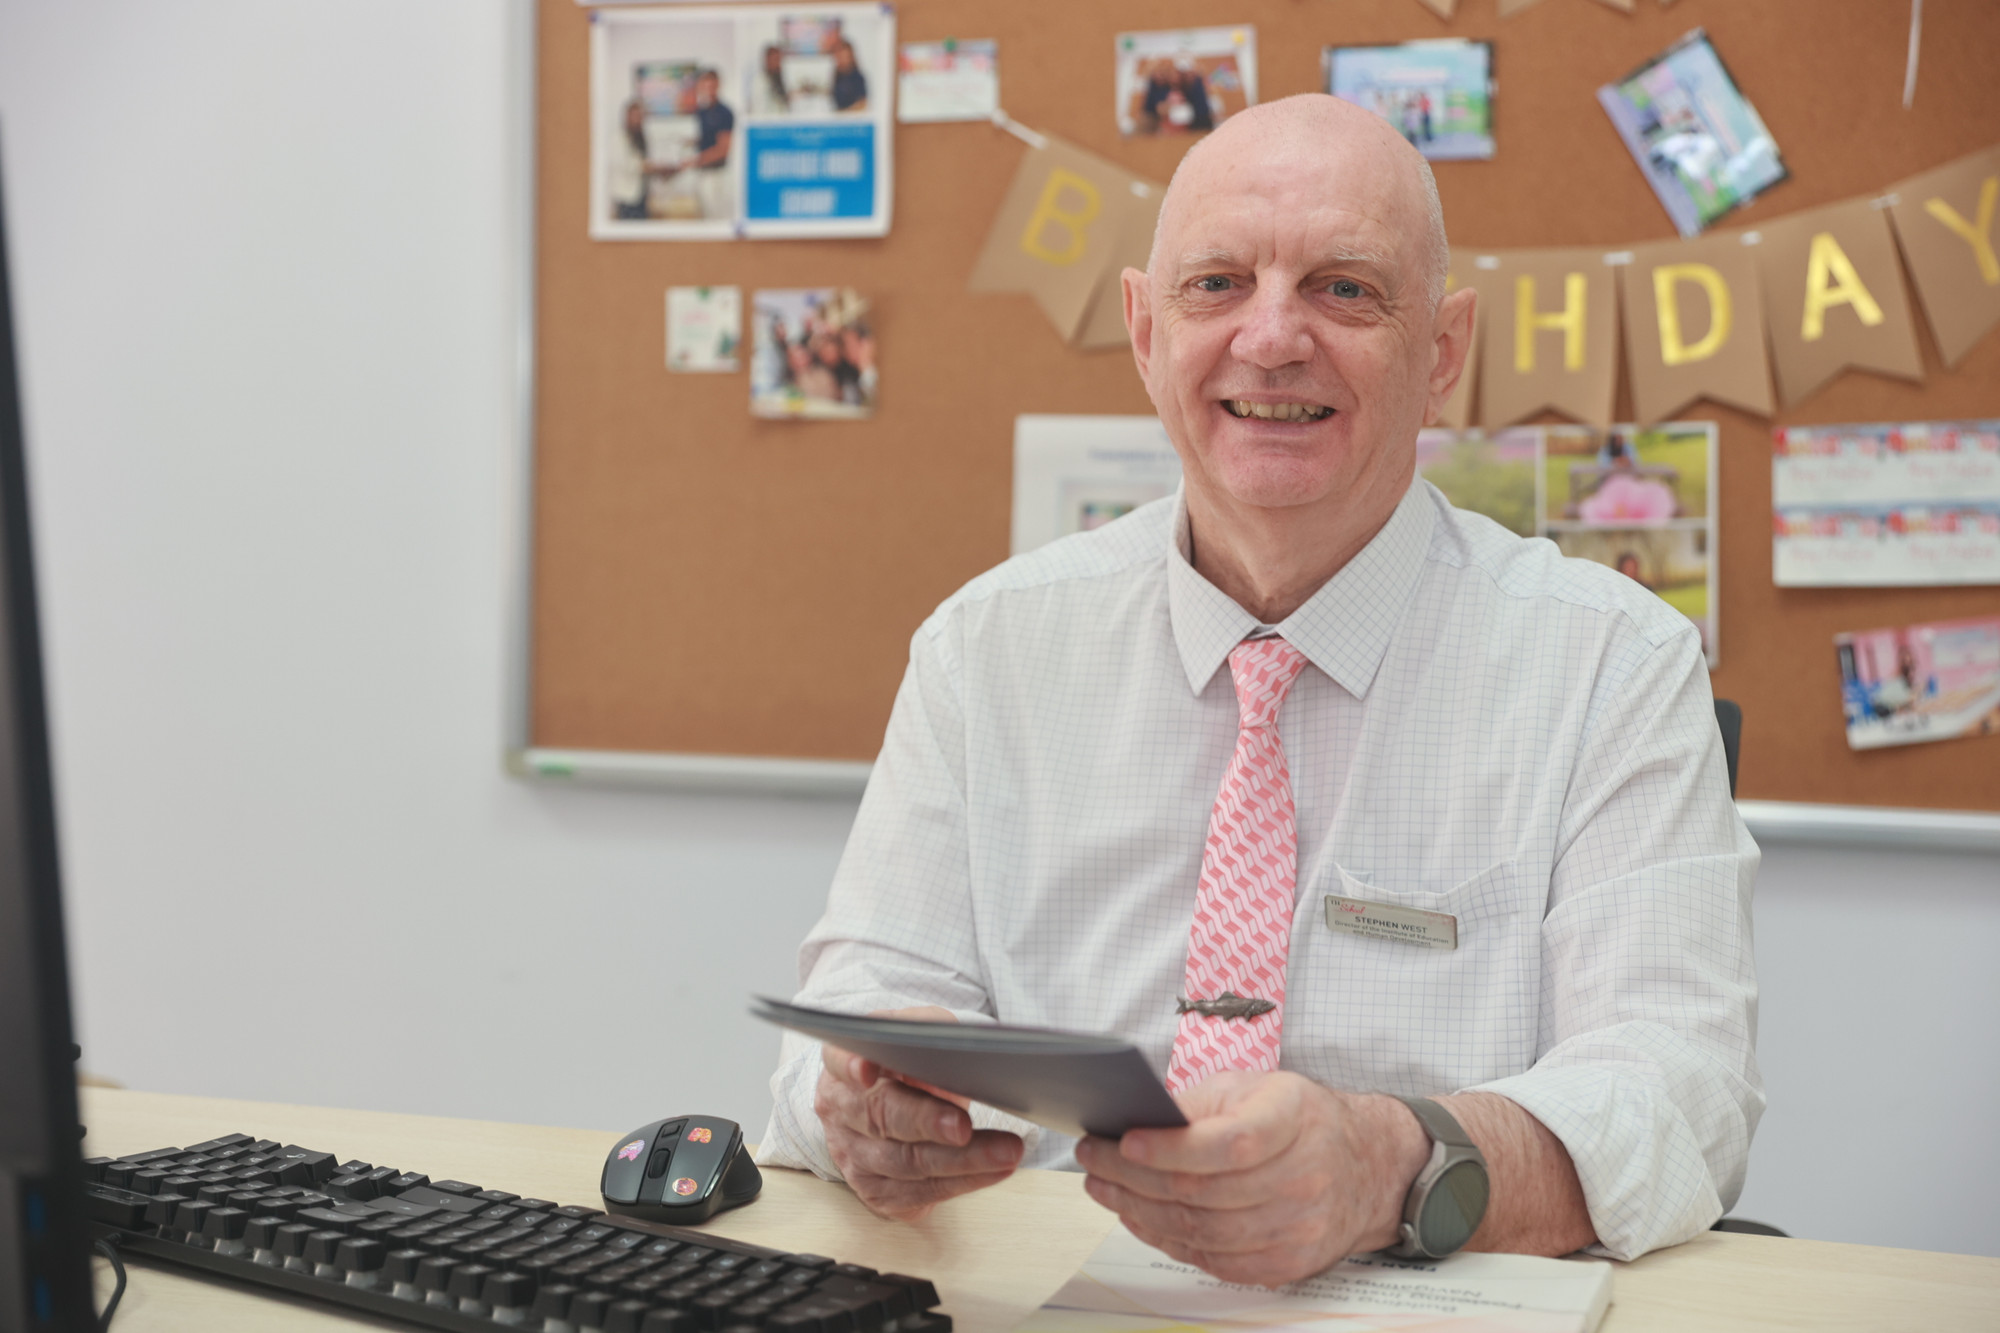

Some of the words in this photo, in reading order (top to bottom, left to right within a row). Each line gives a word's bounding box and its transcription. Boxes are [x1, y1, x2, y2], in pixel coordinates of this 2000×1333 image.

[1335, 920, 1360, 929] Director
[1381, 927, 1408, 937] Institute
[1416, 933, 1449, 944] Education
[1355, 916, 1399, 929] STEPHEN
[1400, 922, 1428, 934] WEST
[1366, 930, 1388, 940] Human
[1389, 934, 1432, 947] Development
[1381, 1261, 1437, 1272] FRAN
